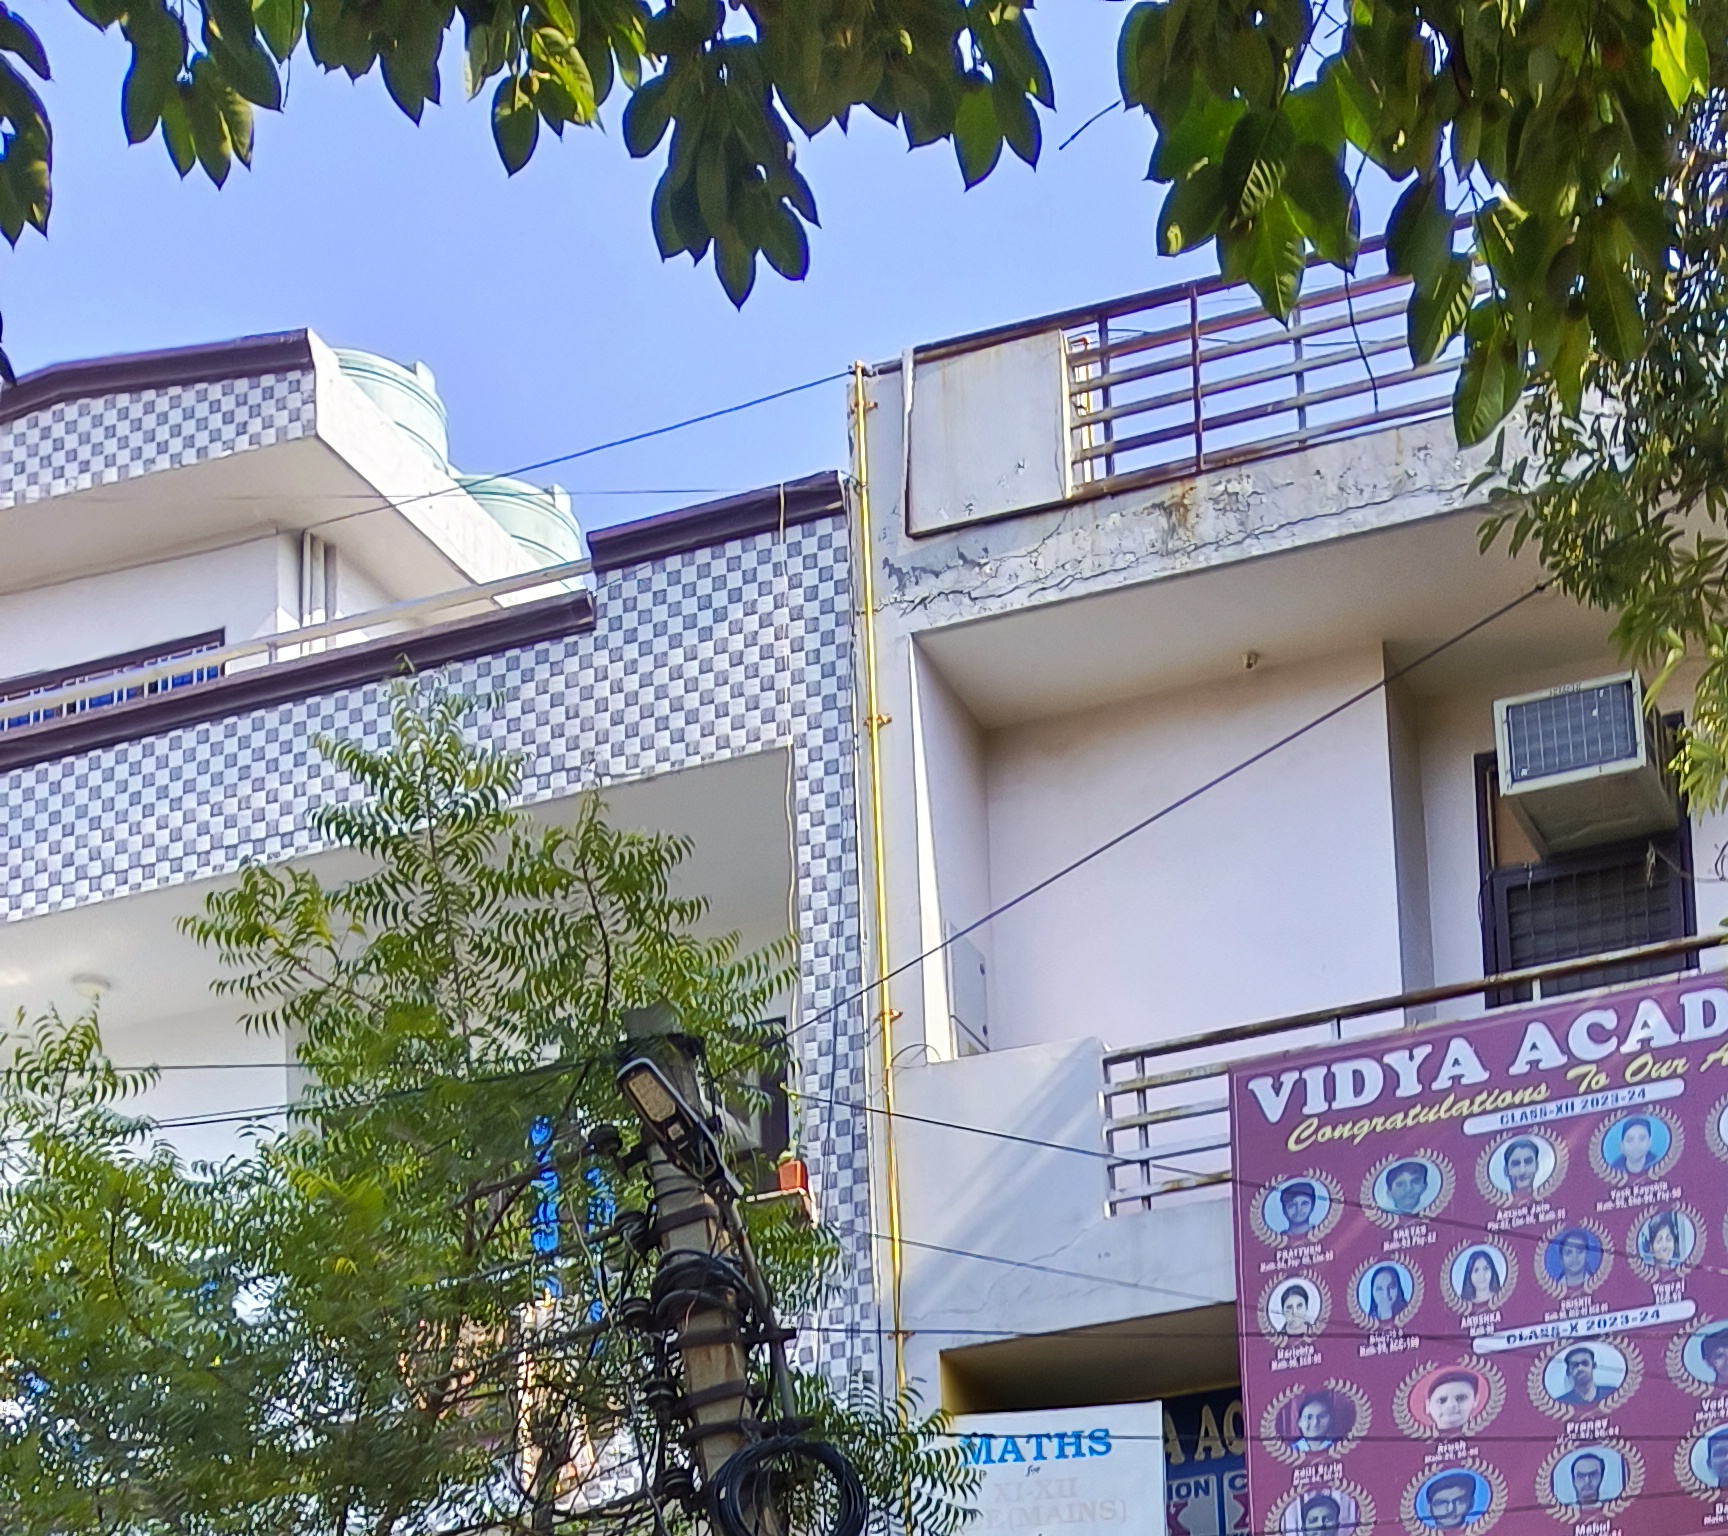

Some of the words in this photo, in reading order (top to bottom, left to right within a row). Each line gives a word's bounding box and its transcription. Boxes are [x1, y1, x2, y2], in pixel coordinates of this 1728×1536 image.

[1249, 1036, 1489, 1122] VIDYA
[1286, 1081, 1550, 1152] Congratulations
[1567, 1063, 1611, 1094] To
[1624, 1052, 1690, 1083] Our
[959, 1428, 1113, 1465] MATHS
